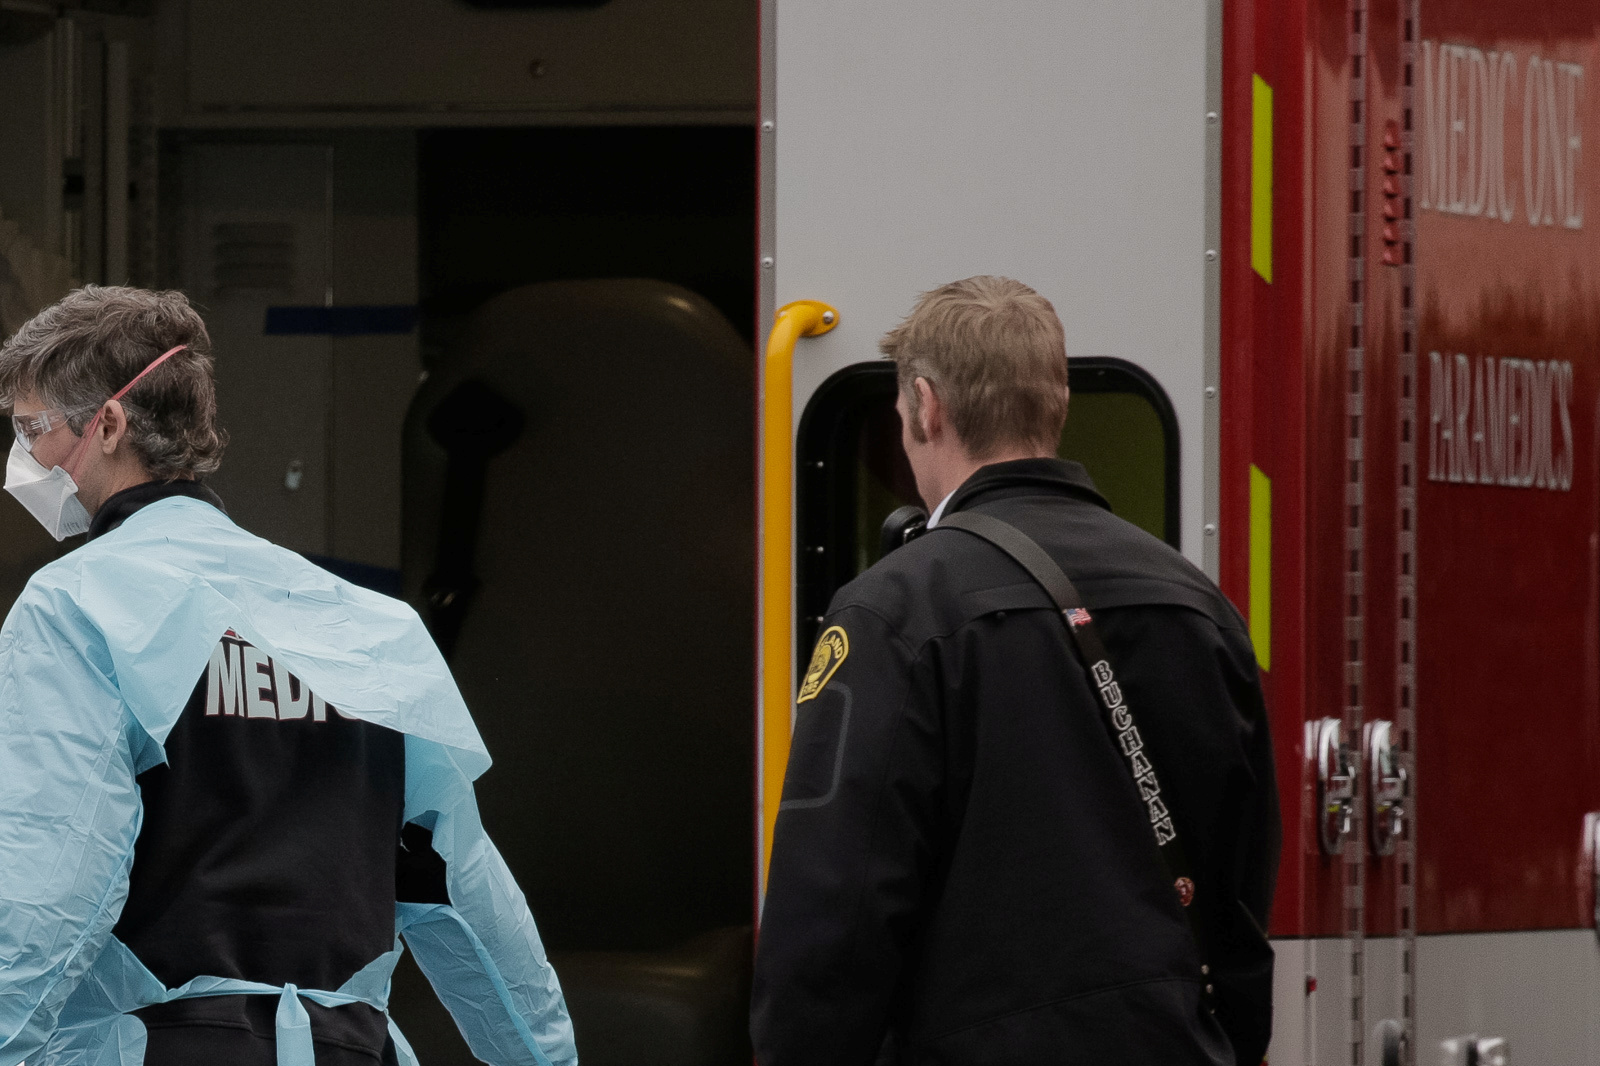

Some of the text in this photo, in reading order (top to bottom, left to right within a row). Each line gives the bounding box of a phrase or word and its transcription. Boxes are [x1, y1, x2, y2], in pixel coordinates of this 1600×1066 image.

[1420, 39, 1584, 230] MEDIC ONE
[1428, 351, 1574, 492] PARAMEDICS
[205, 641, 362, 723] MED
[1091, 660, 1176, 846] BUCHANAN
